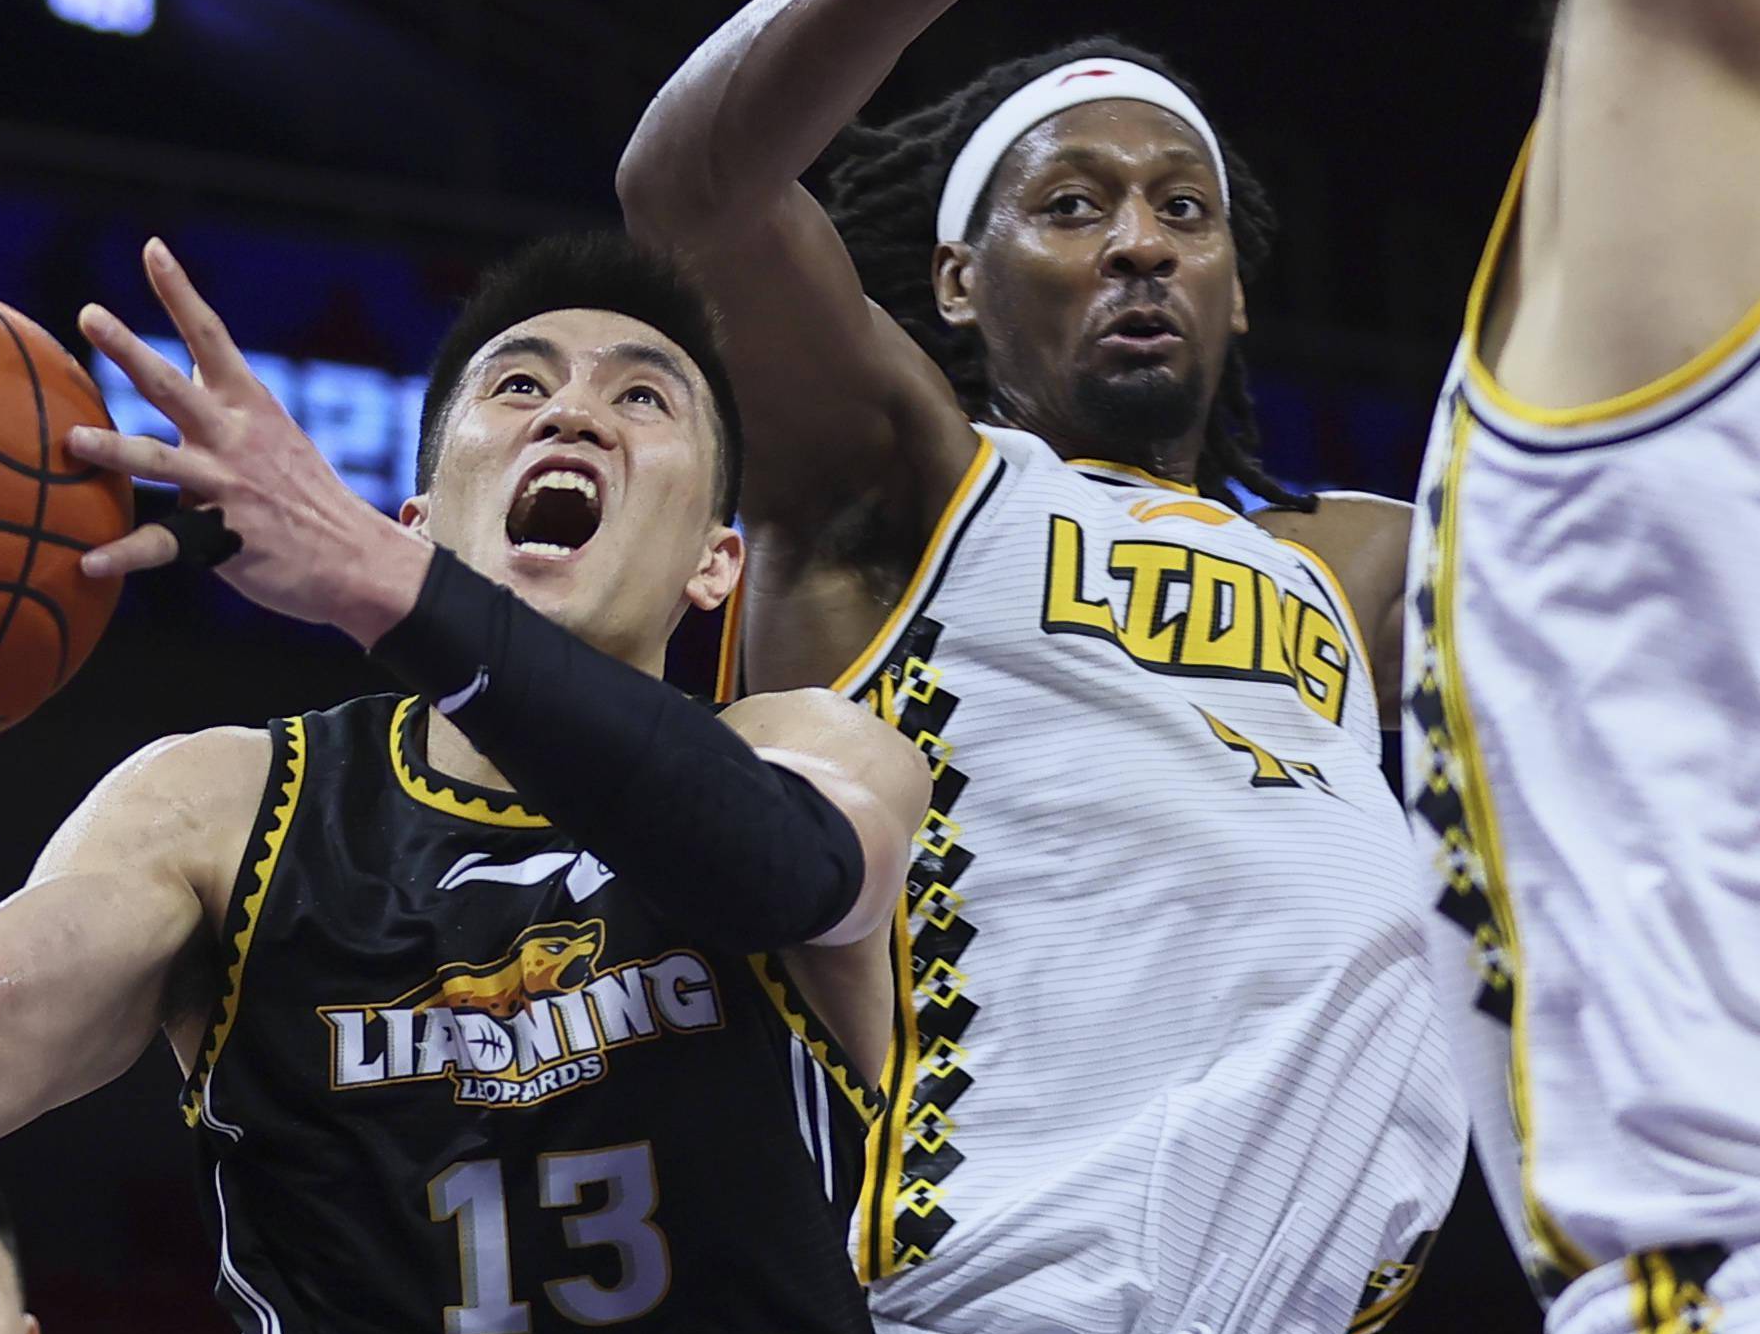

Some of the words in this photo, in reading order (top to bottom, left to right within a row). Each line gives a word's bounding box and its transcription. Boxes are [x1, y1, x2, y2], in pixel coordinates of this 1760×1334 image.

[1041, 513, 1349, 728] LIONS
[320, 950, 725, 1089] LIAONING
[459, 1054, 604, 1105] LEOPARDS
